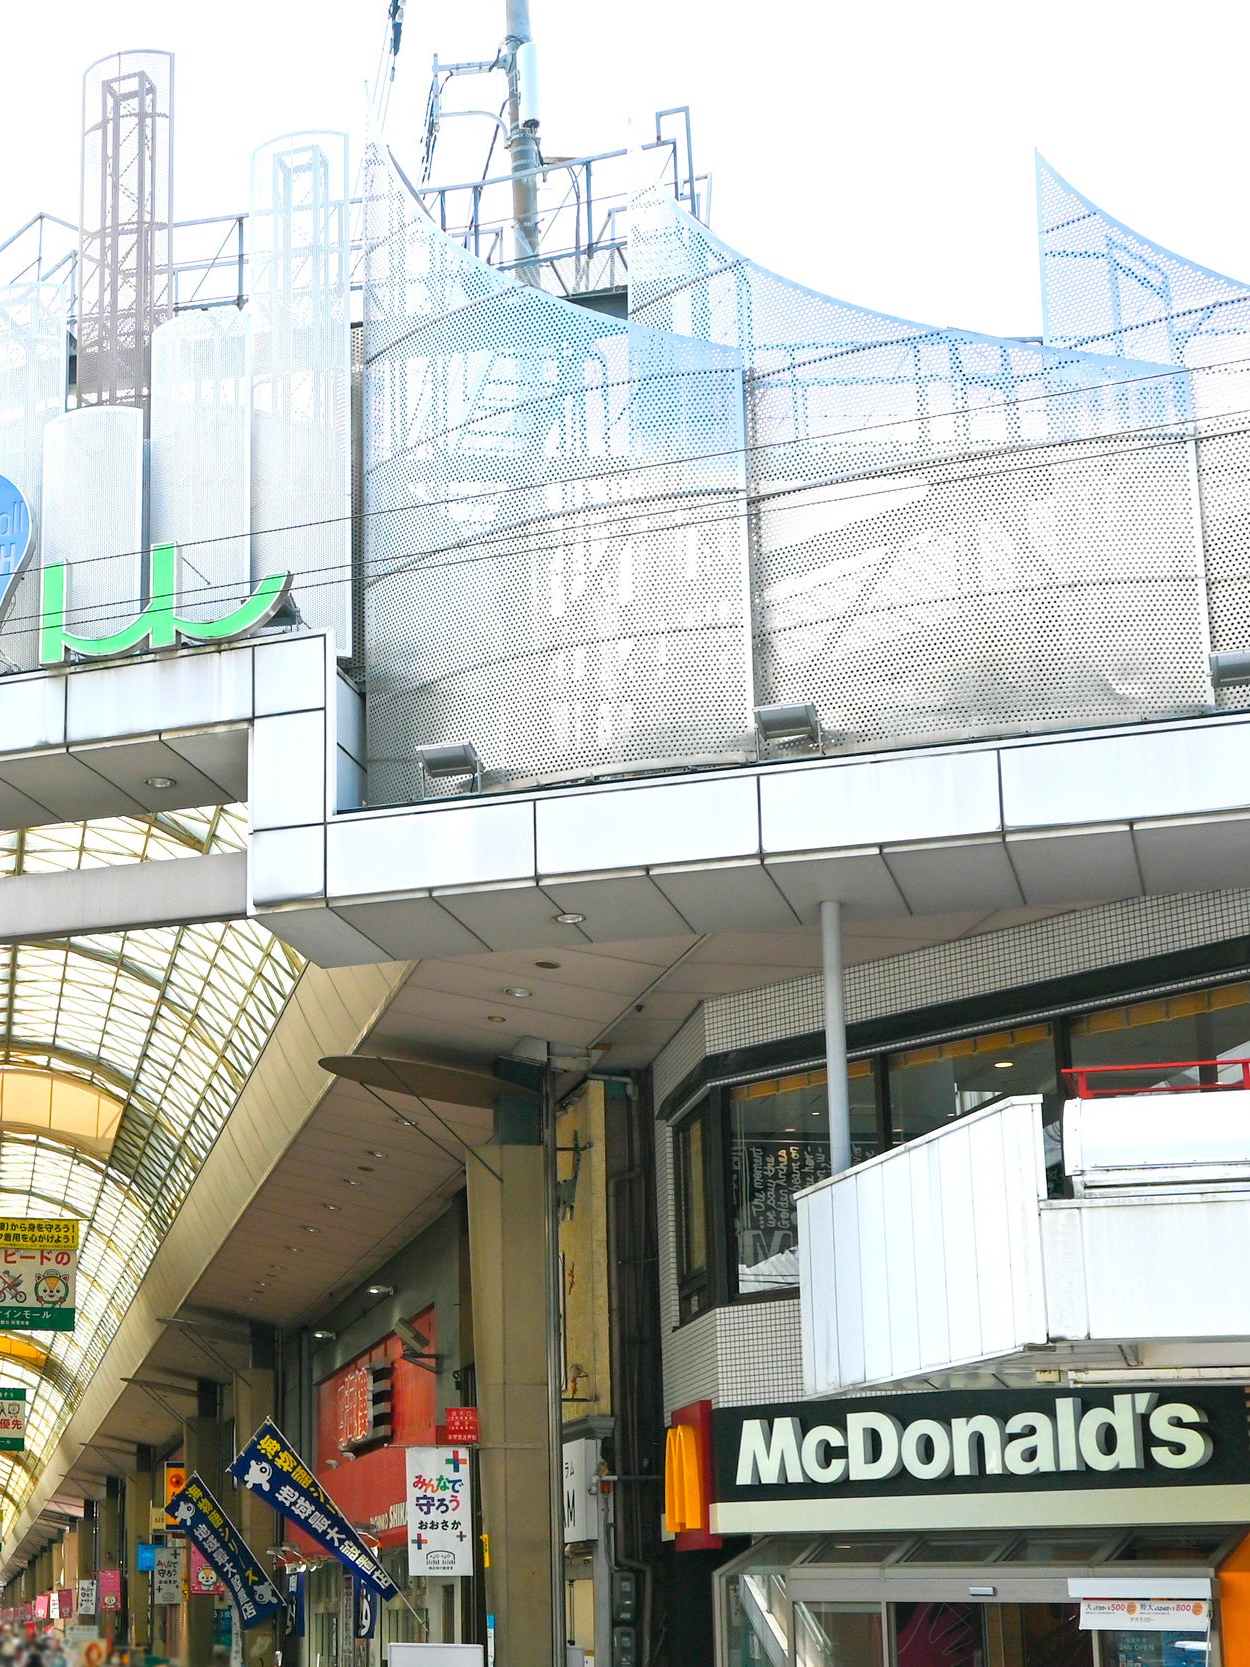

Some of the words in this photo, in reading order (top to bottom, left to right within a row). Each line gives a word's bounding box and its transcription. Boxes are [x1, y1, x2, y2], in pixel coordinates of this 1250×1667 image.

[413, 1474, 464, 1493] みんなで
[415, 1494, 461, 1515] 守ろう
[418, 1519, 462, 1531] おおさか
